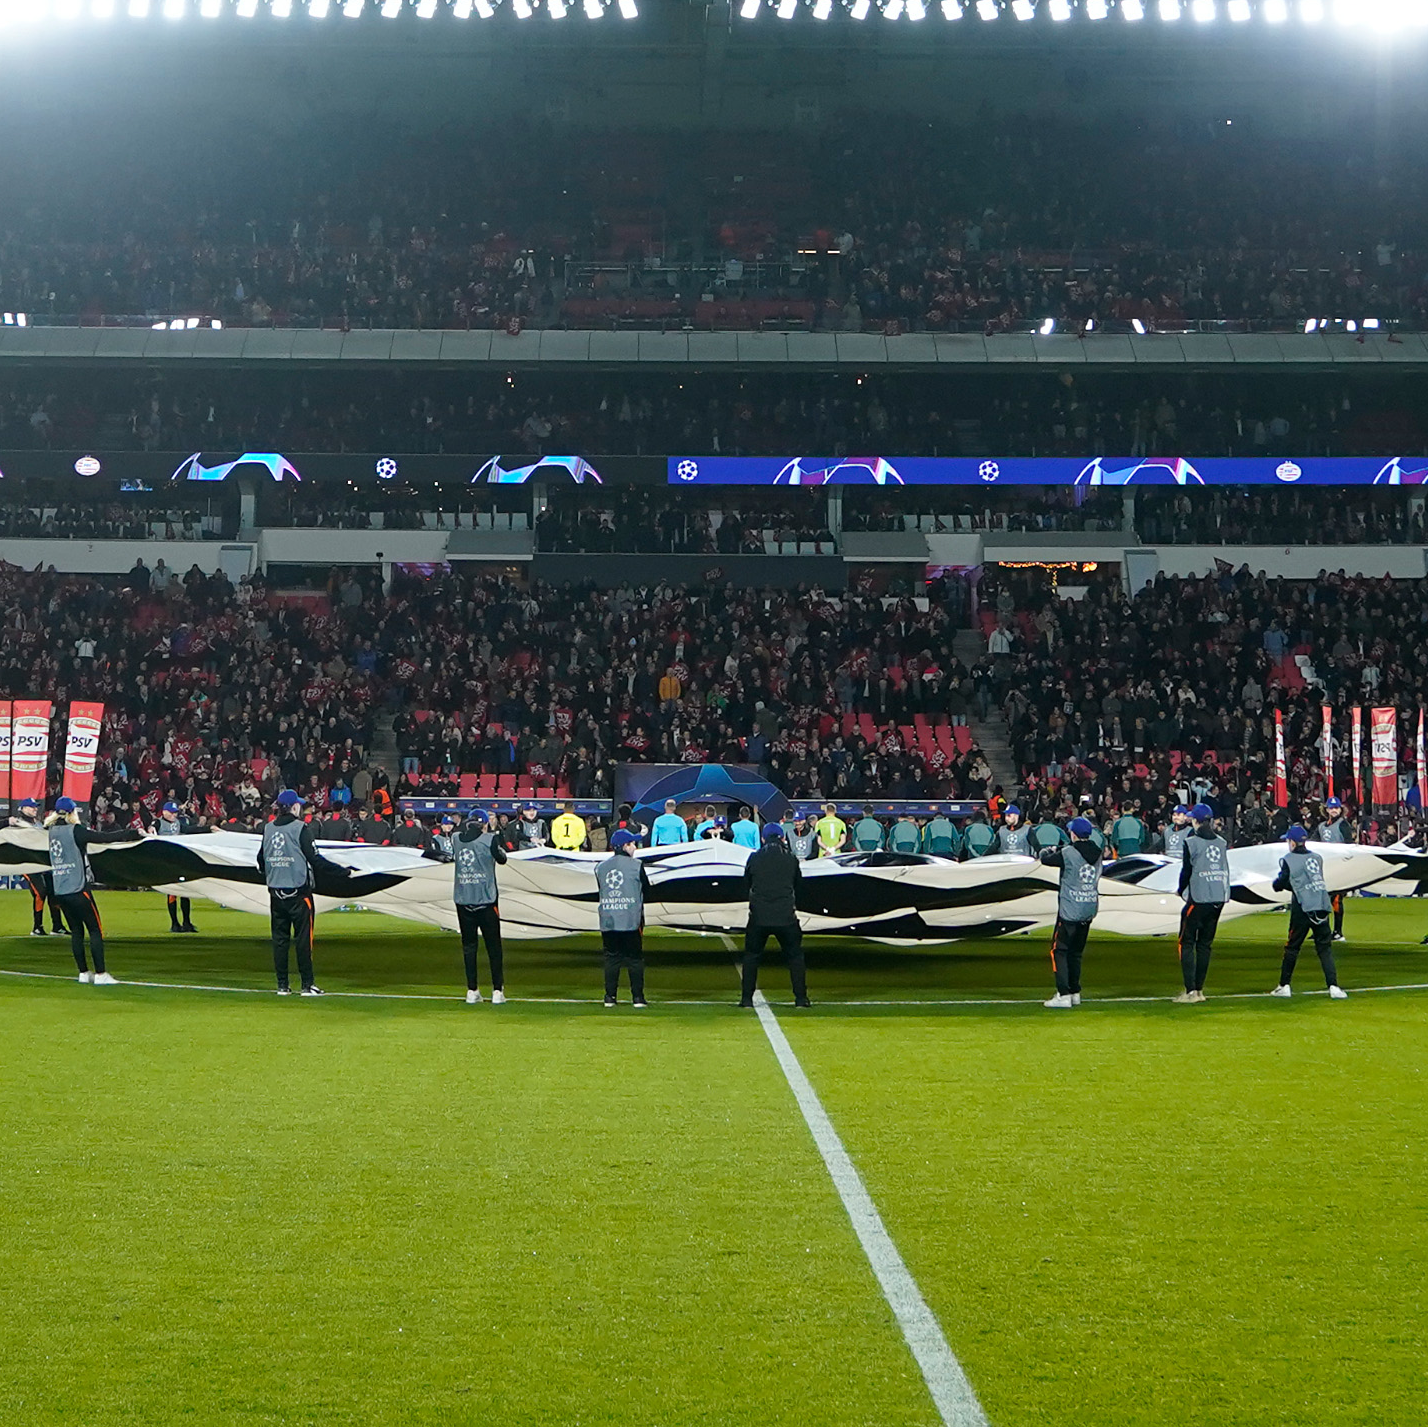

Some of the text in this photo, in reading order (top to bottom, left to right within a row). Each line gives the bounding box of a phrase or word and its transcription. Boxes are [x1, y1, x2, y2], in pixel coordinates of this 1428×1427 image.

[17, 735, 43, 747] PSV
[71, 735, 93, 748] PSV
[563, 823, 570, 837] 1
[830, 823, 835, 839] 1
